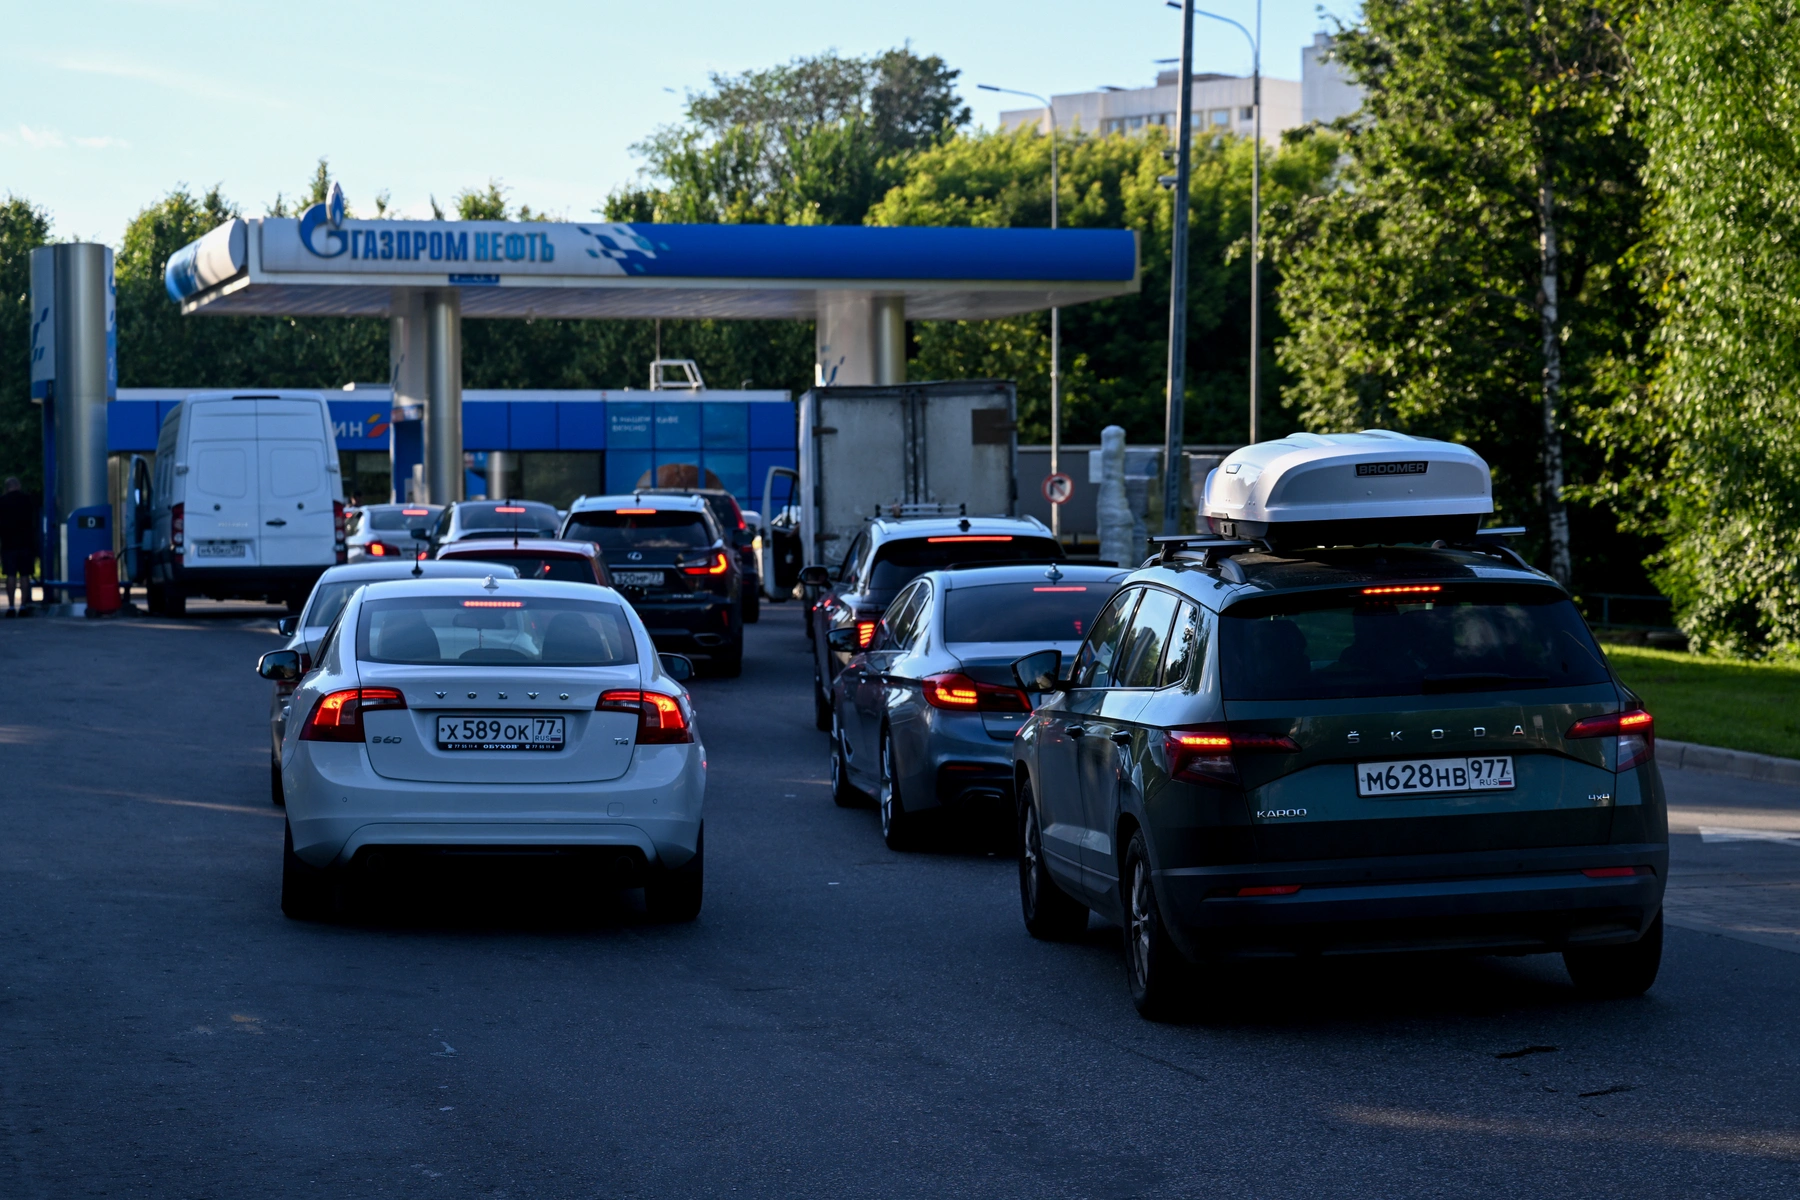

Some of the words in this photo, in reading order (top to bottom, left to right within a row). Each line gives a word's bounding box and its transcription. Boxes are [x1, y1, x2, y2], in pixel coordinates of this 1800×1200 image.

[351, 229, 468, 261] ГАЗПРОМ
[474, 231, 555, 262] НЕФТЬ
[1359, 463, 1425, 474] BROOMER
[435, 691, 569, 700] VOLVO
[1347, 725, 1524, 743] ŠKODA
[372, 735, 402, 744] S60
[613, 737, 629, 746] T4
[1479, 777, 1498, 786] RUS
[1256, 808, 1307, 818] KAROQ
